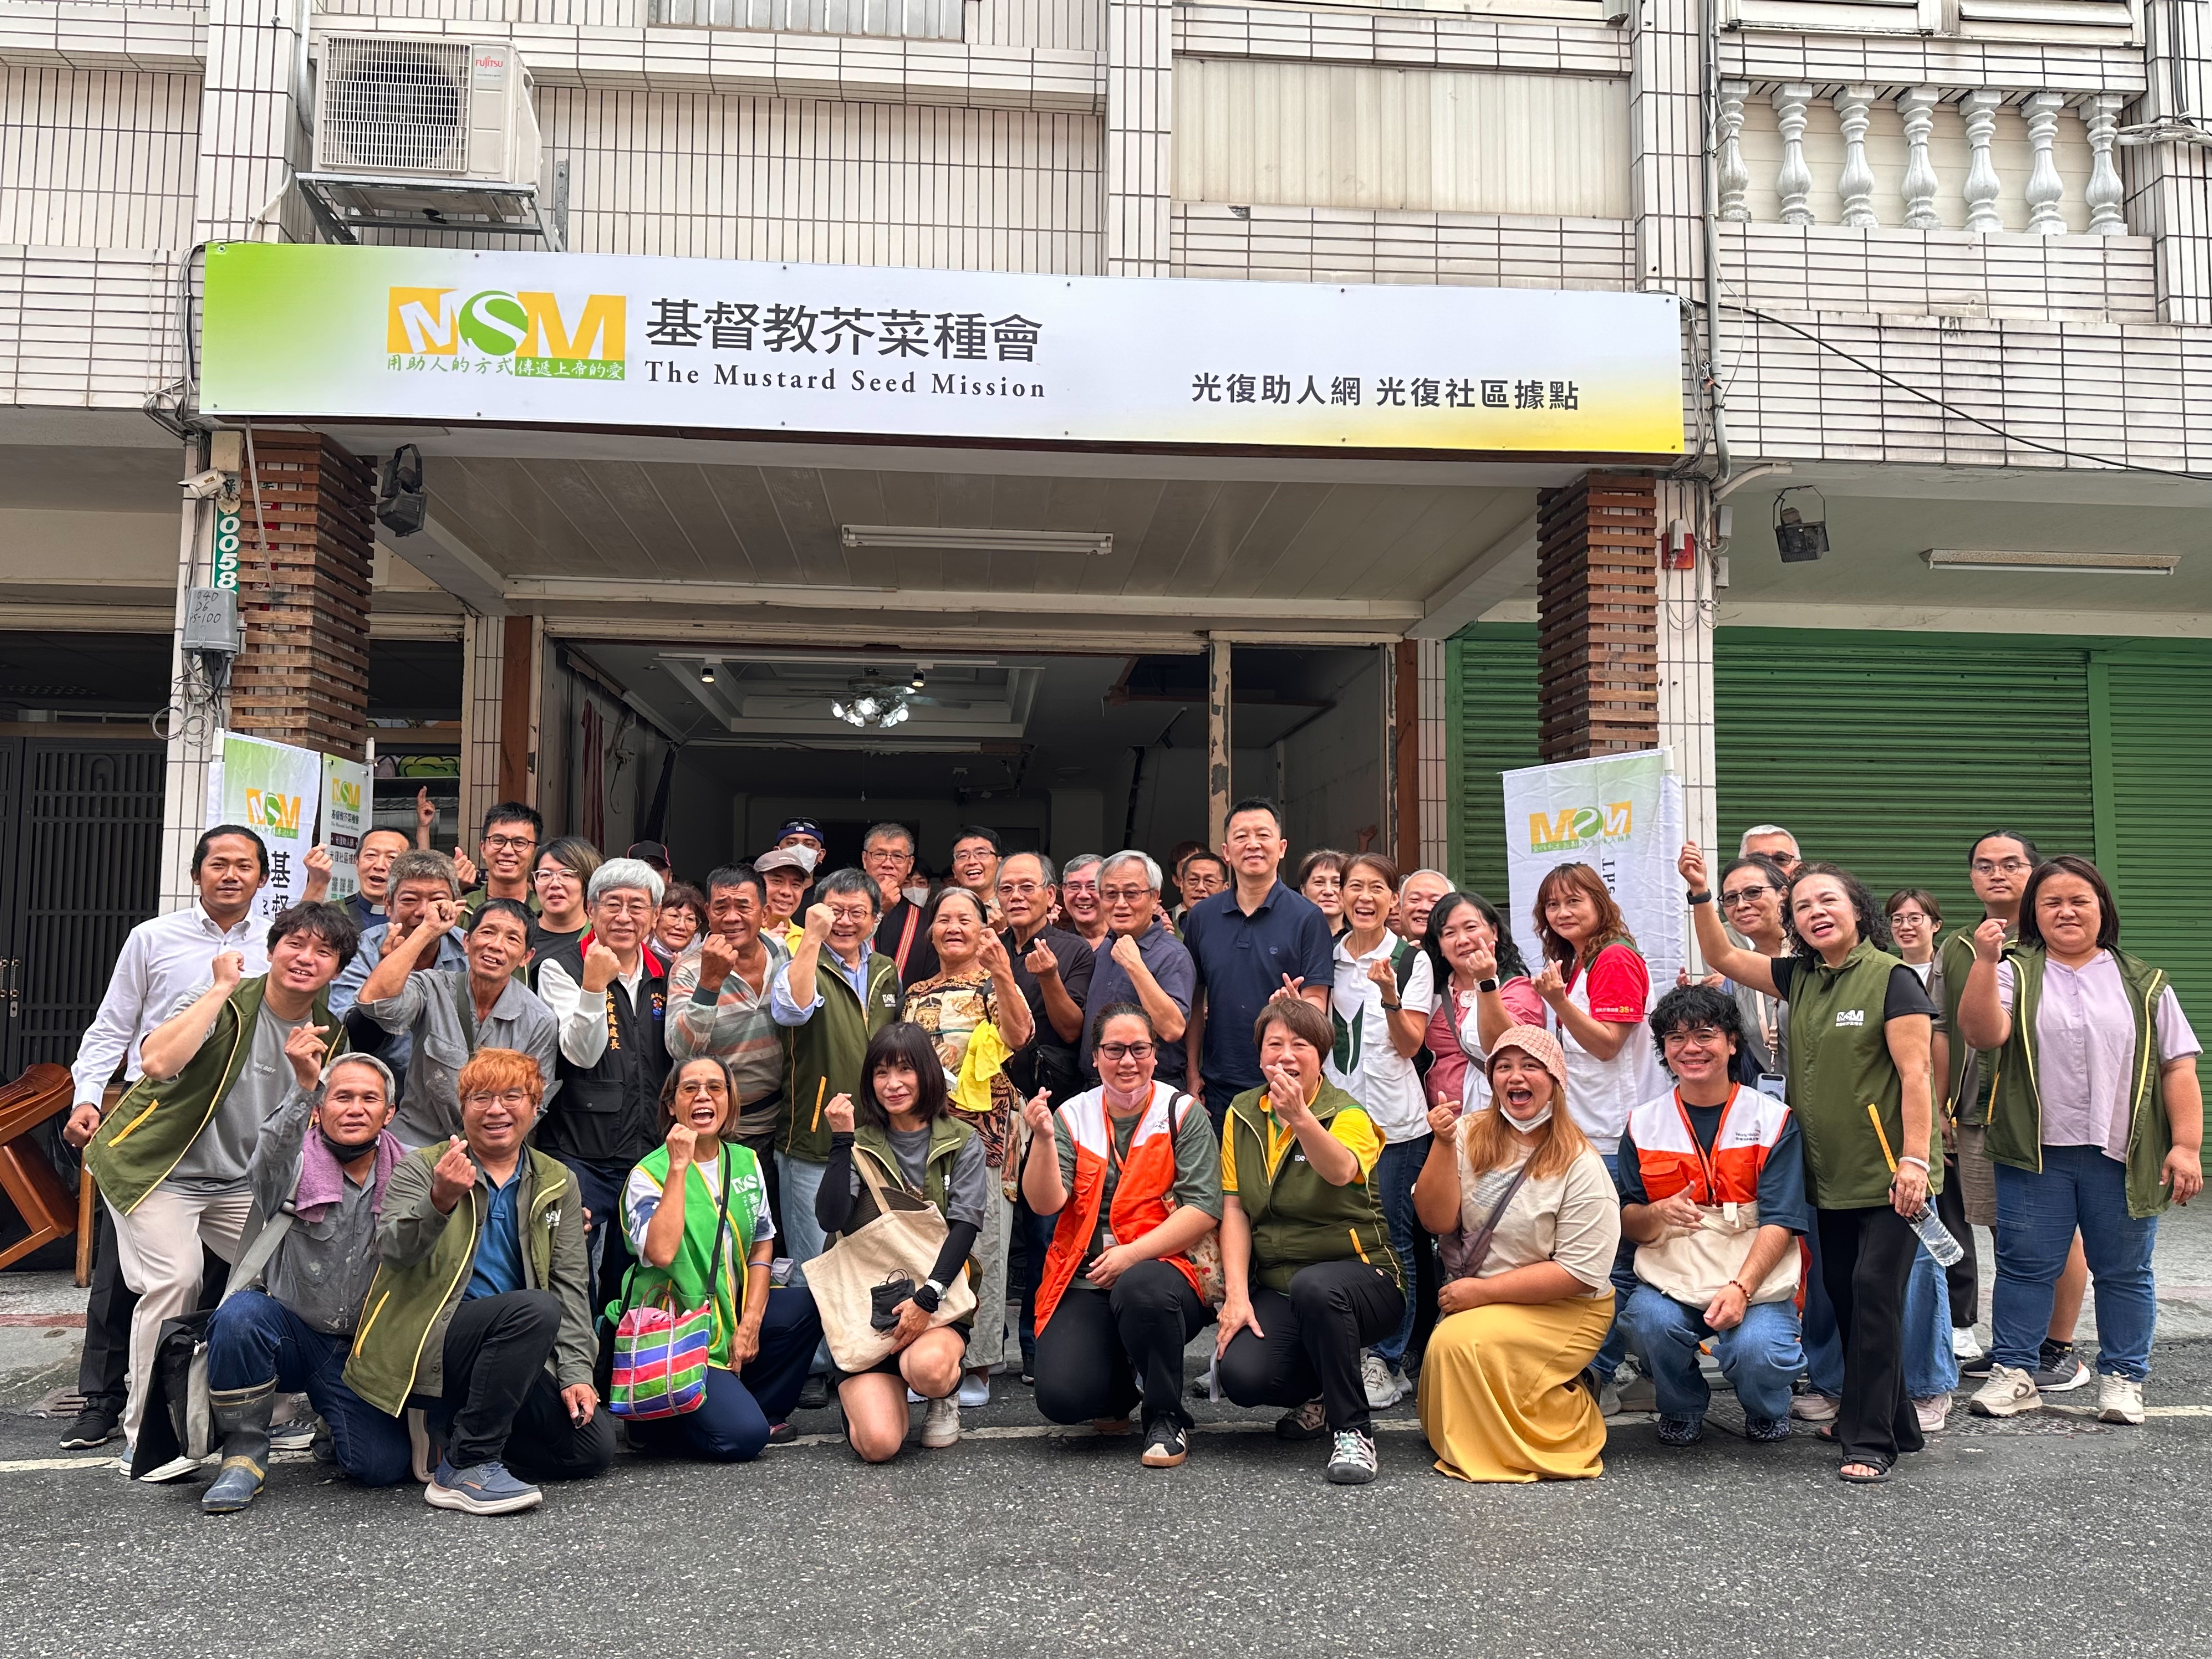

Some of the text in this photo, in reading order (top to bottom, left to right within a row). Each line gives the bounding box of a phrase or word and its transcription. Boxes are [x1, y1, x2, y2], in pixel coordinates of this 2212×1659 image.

[476, 55, 504, 69] FUJITSU
[645, 297, 1043, 362] 基督教芥菜種會
[645, 360, 1046, 398] The Mustard Seed Mission
[1192, 372, 1579, 411] 光復助人網 光復社區據點
[217, 512, 240, 595] 0058
